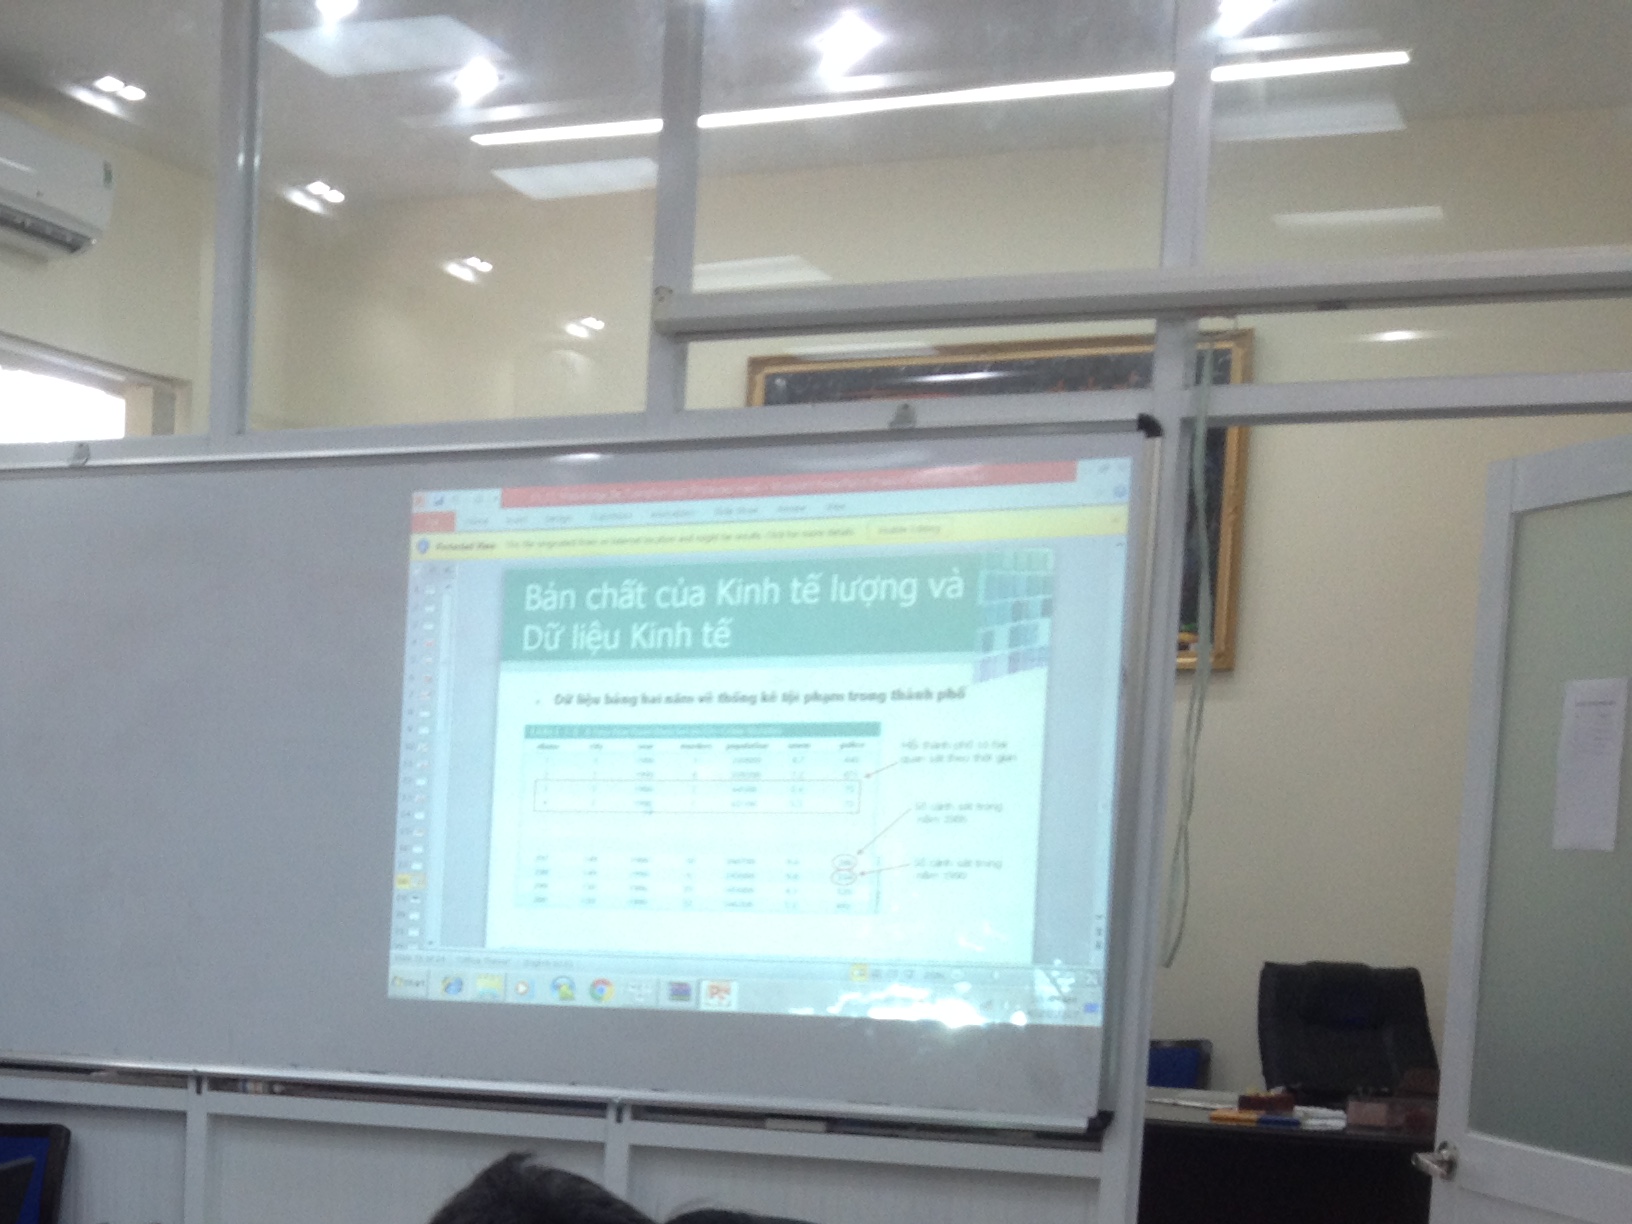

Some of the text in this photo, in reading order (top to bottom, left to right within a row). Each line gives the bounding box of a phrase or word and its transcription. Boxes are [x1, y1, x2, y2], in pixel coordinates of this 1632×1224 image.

[524, 565, 965, 612] Bản chất của Kinh tế lượng và
[522, 616, 734, 656] Dữ liệu Kinh tế
